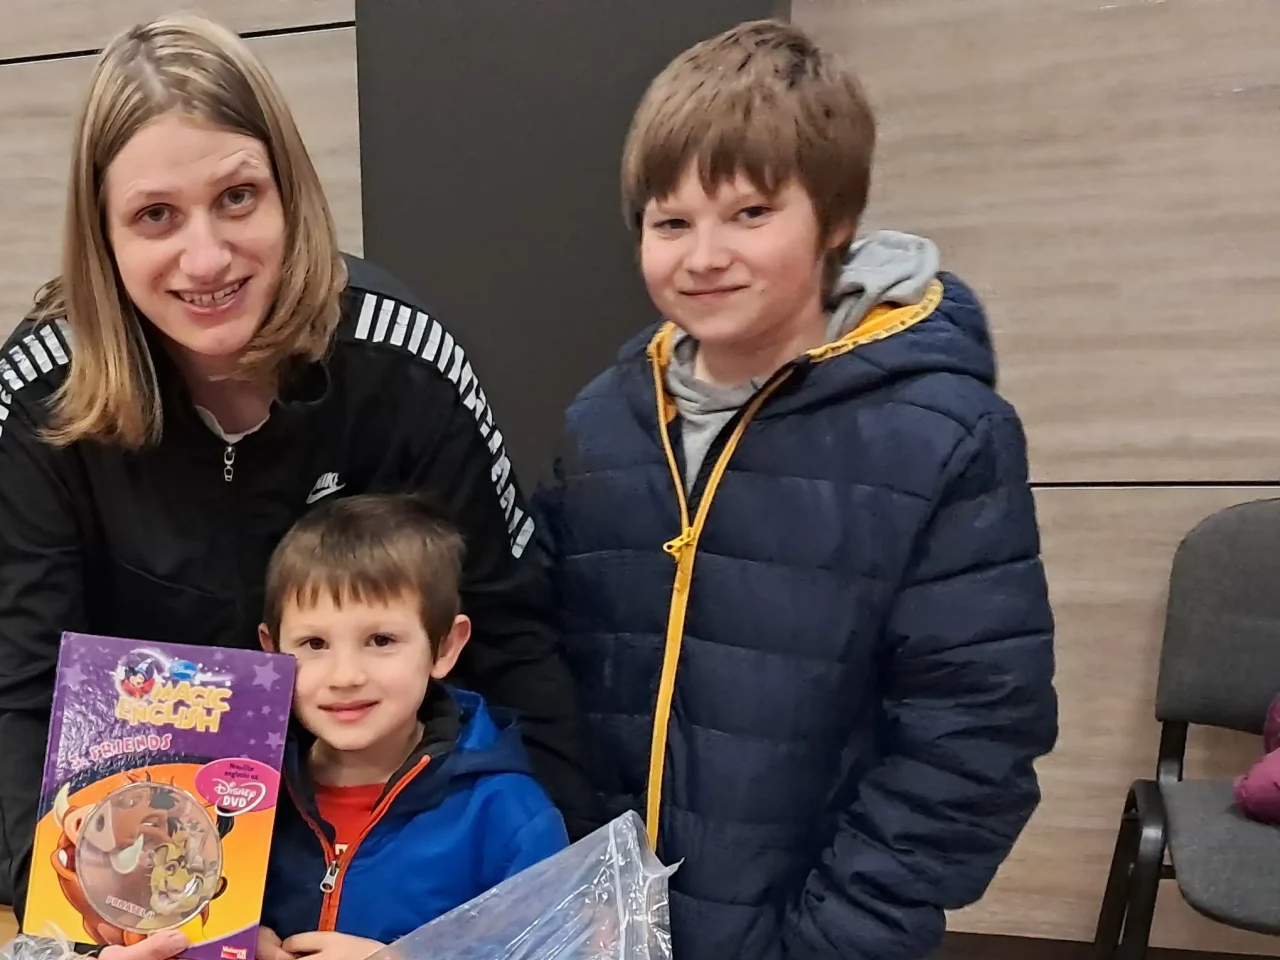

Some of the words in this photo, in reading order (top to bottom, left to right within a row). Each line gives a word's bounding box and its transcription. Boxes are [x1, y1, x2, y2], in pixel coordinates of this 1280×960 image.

[152, 680, 233, 712] MAGIC
[114, 699, 221, 733] ENGLISH
[88, 733, 172, 762] FRIENDS
[222, 795, 247, 808] DVD
